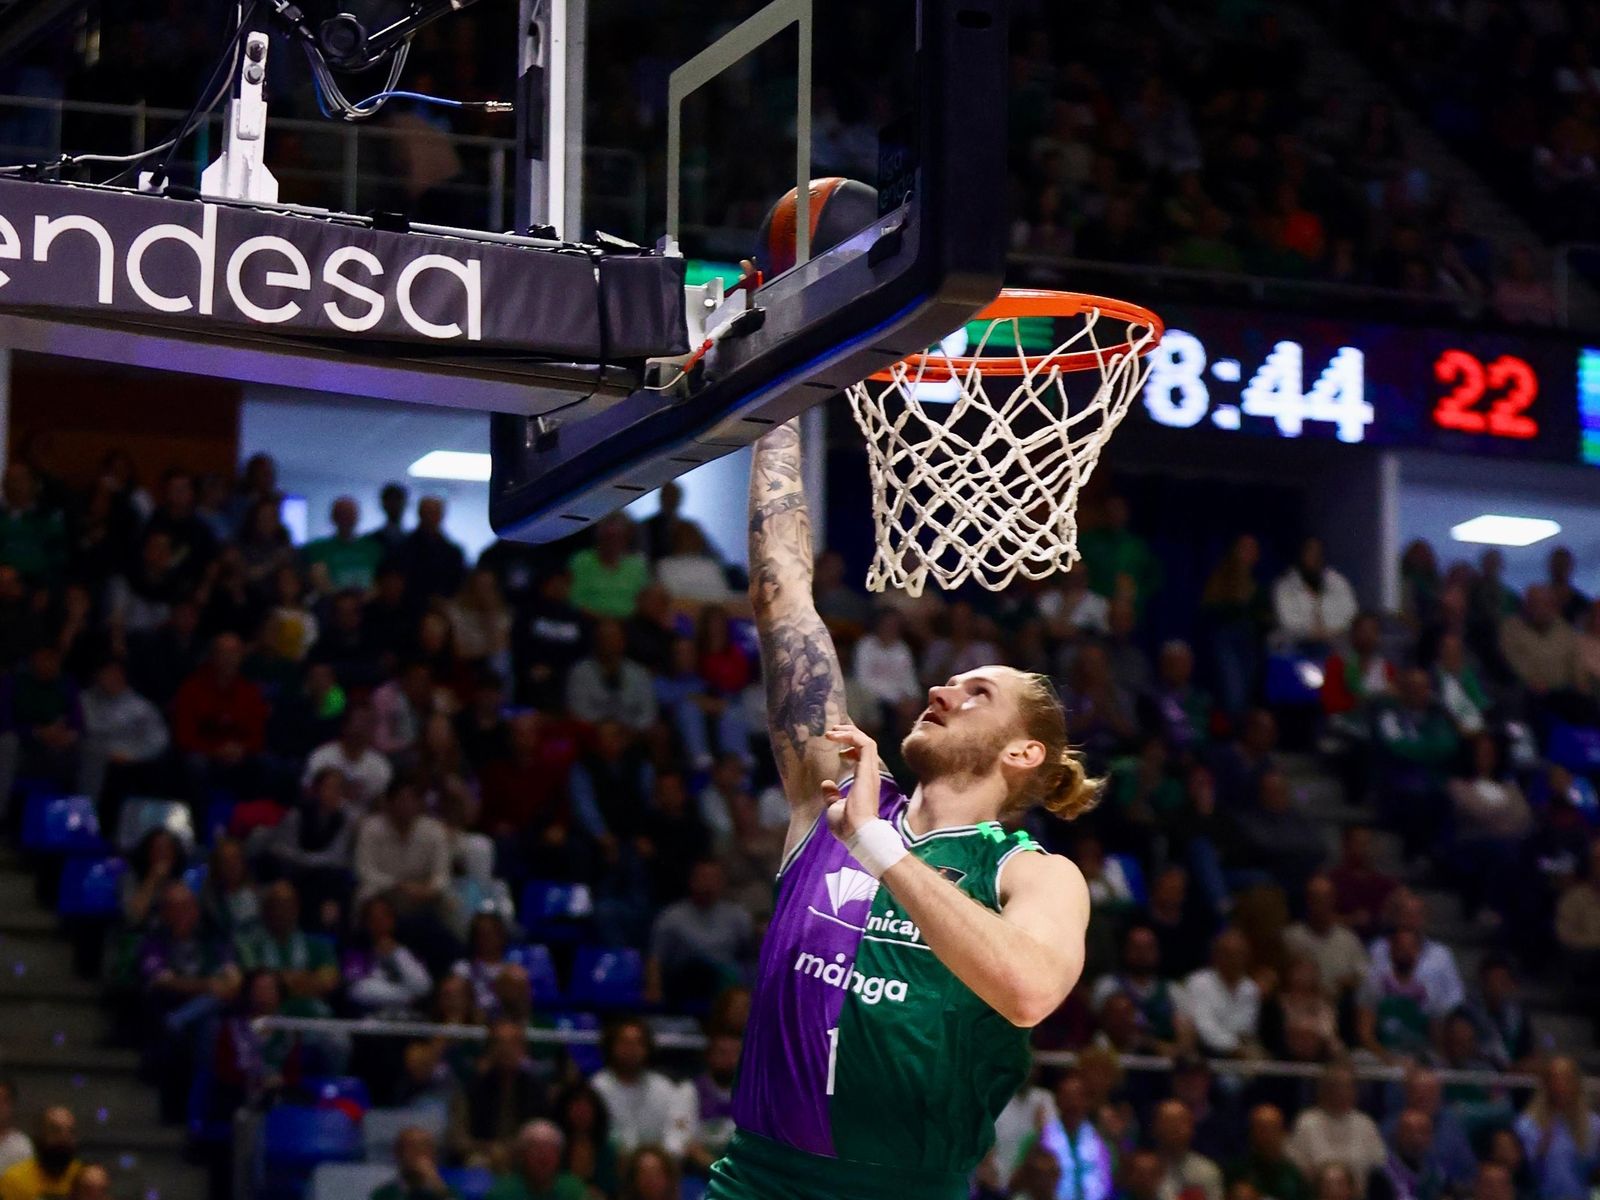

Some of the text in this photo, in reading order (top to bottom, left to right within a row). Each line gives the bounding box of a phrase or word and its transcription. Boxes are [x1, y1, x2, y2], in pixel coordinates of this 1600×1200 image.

[0, 203, 482, 341] ndesa
[1143, 329, 1375, 444] 8:44
[1433, 348, 1539, 440] 22
[865, 909, 921, 942] nicaj
[826, 1027, 840, 1095] 1
